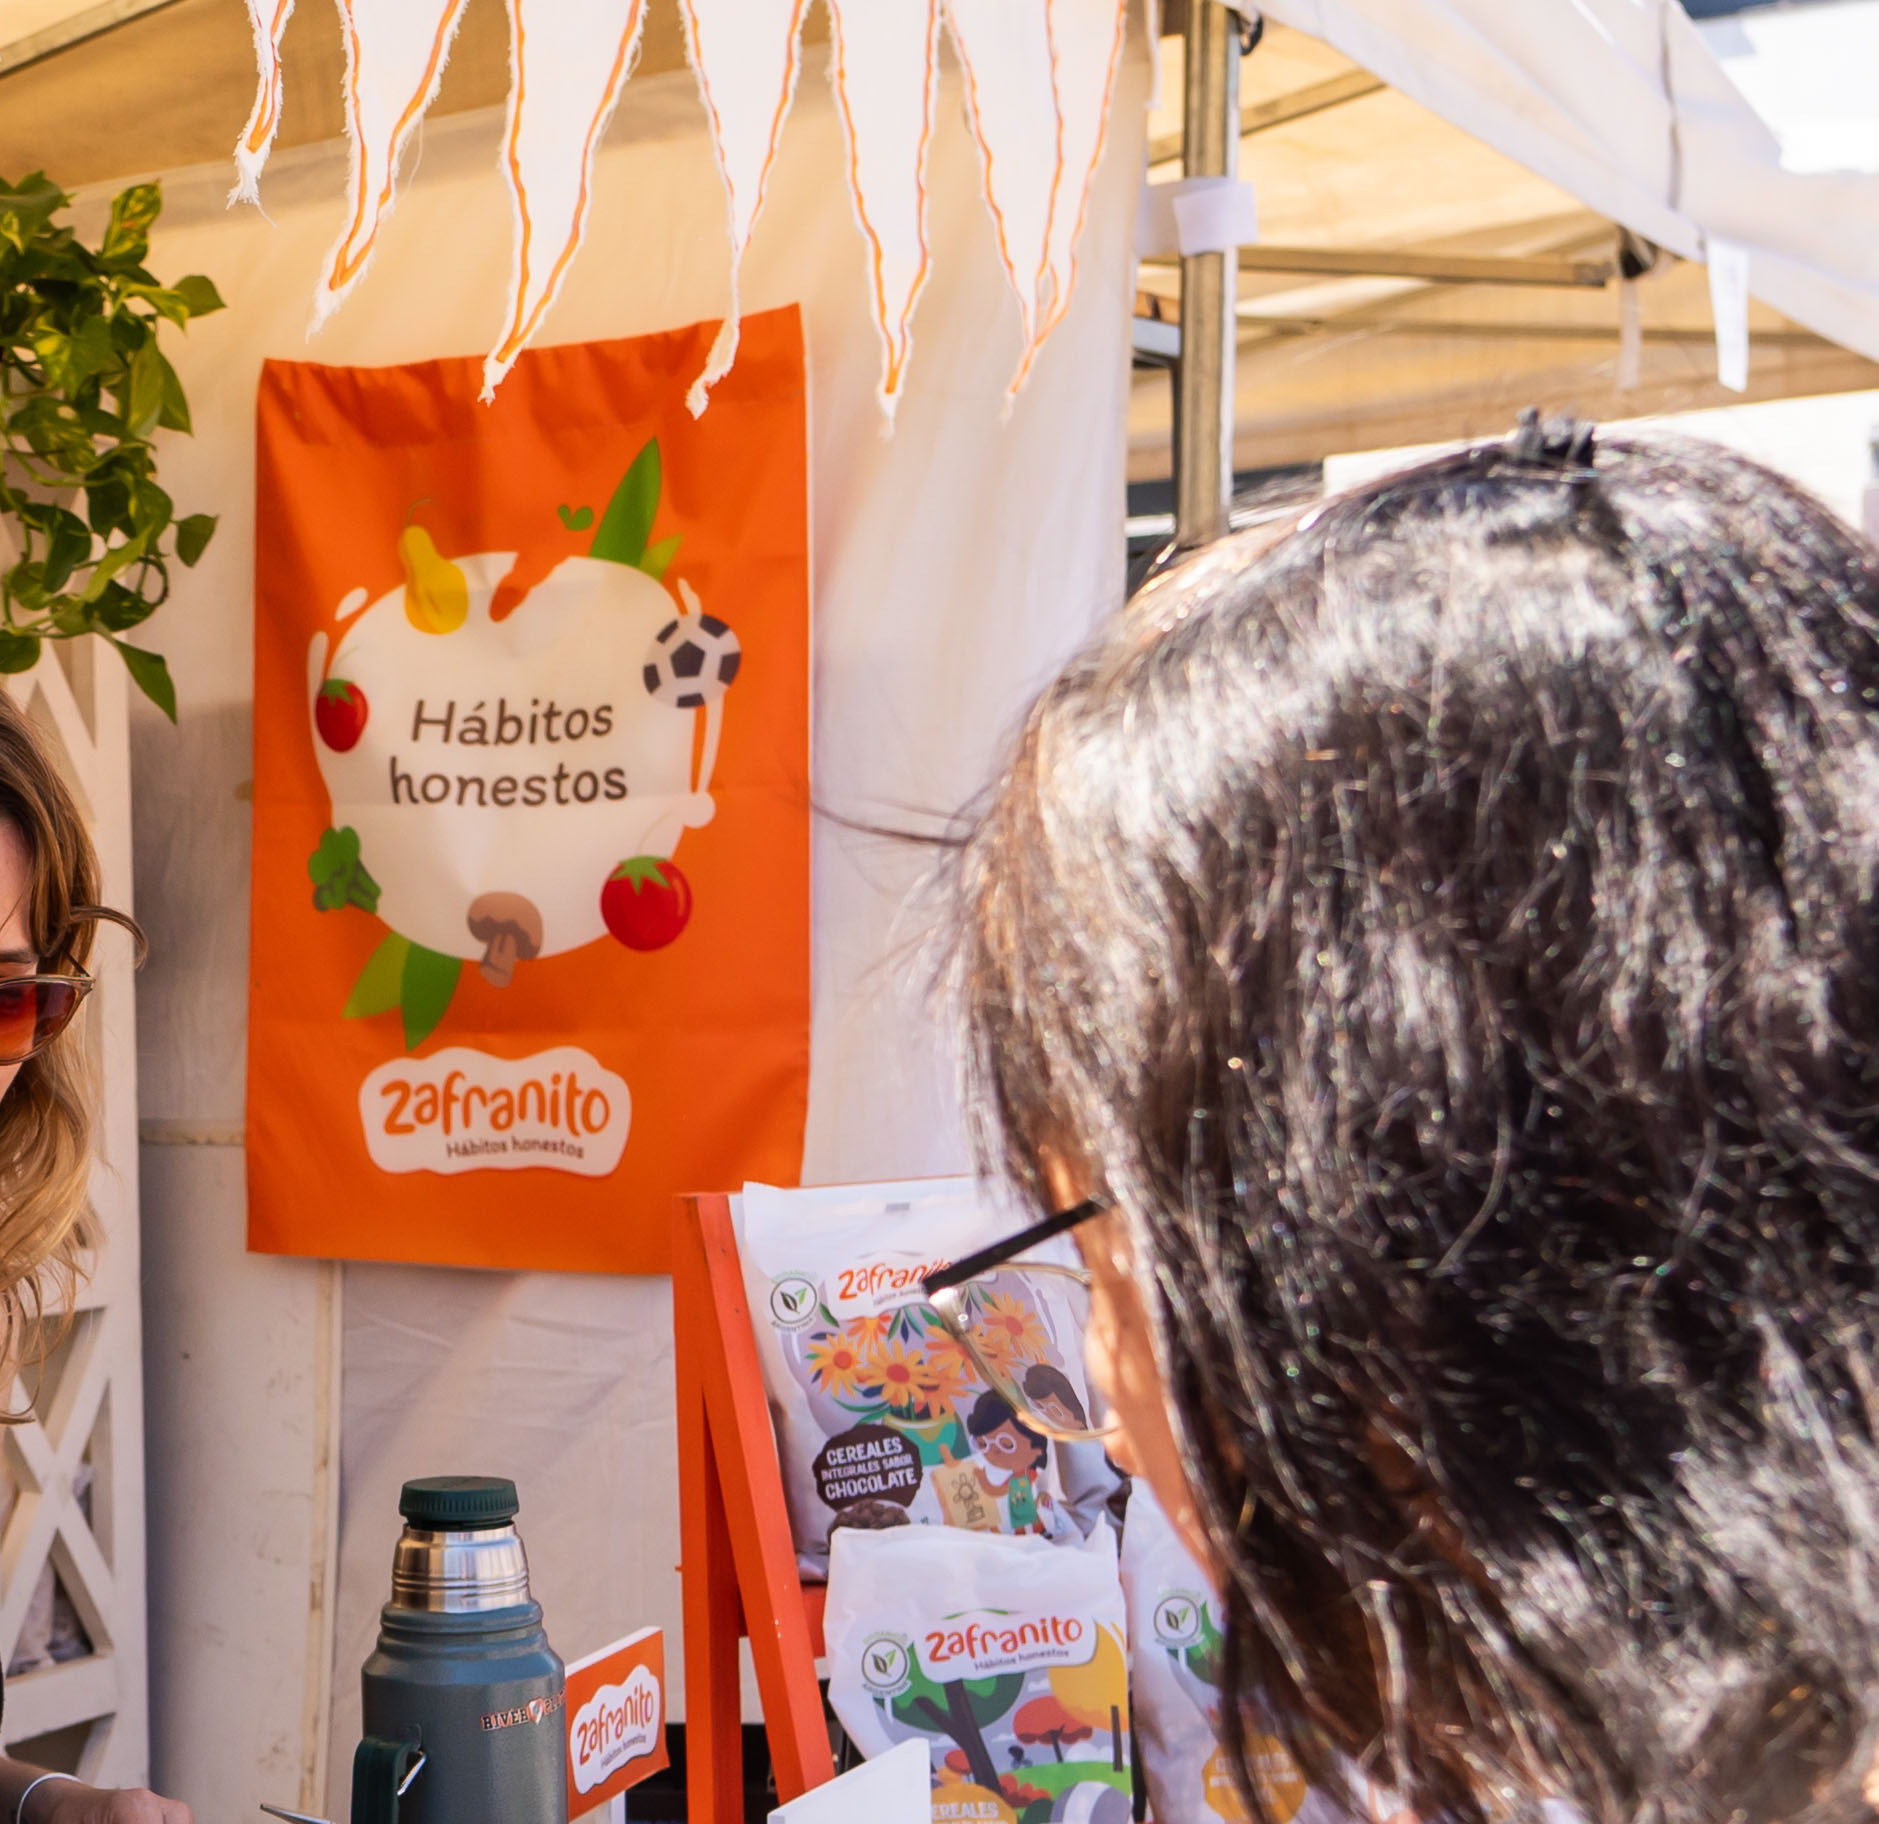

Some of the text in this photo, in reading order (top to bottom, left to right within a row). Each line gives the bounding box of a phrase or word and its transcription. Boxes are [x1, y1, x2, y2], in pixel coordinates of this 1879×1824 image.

[410, 698, 614, 745] Hábitos
[388, 757, 628, 807] honestos
[446, 1135, 585, 1160] Hábitos honestos
[826, 1436, 903, 1467] CEREALES
[821, 1460, 881, 1481] INTEGRALES
[825, 1467, 918, 1500] CHOCOLATE
[483, 1708, 529, 1730] RIVER
